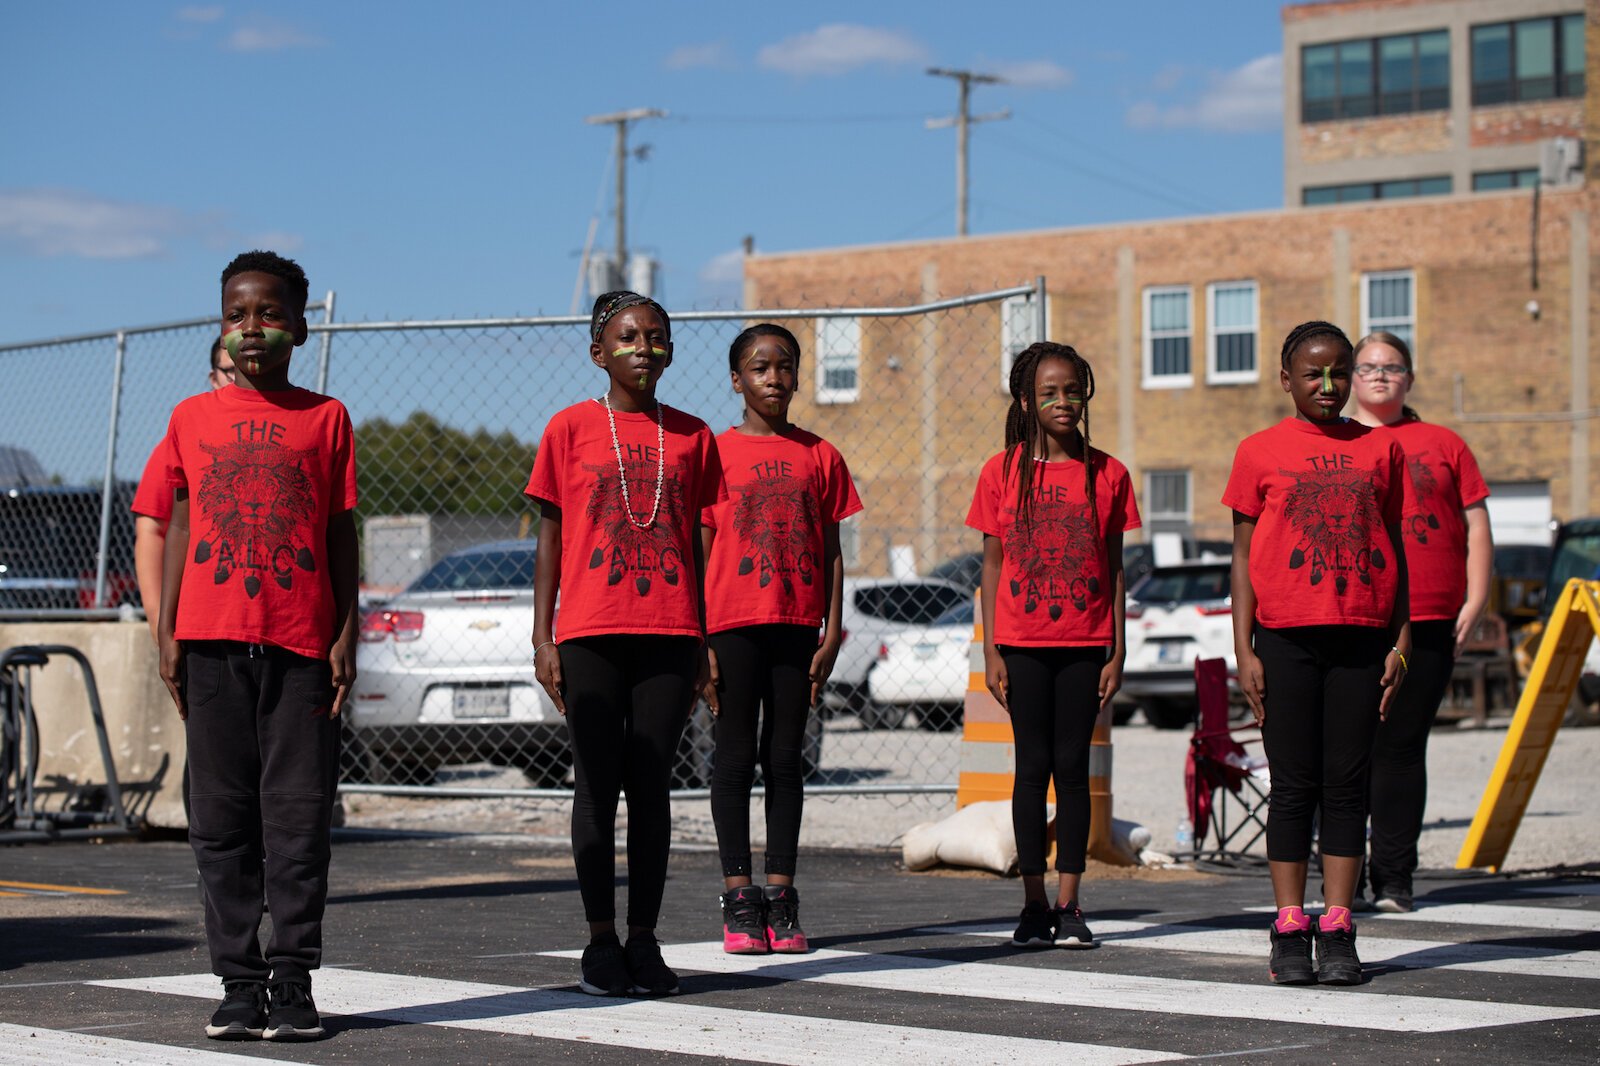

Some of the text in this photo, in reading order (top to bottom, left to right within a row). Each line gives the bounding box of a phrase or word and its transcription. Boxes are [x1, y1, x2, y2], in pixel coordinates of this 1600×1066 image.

[232, 420, 287, 447] THE
[750, 460, 793, 480] THE
[1306, 453, 1354, 471] THE
[217, 538, 295, 576] A.L.C
[610, 543, 679, 575] A.L.C
[760, 549, 813, 575] A.L.C
[1311, 544, 1371, 575] A.L.C
[1026, 575, 1087, 604] A.L.C
